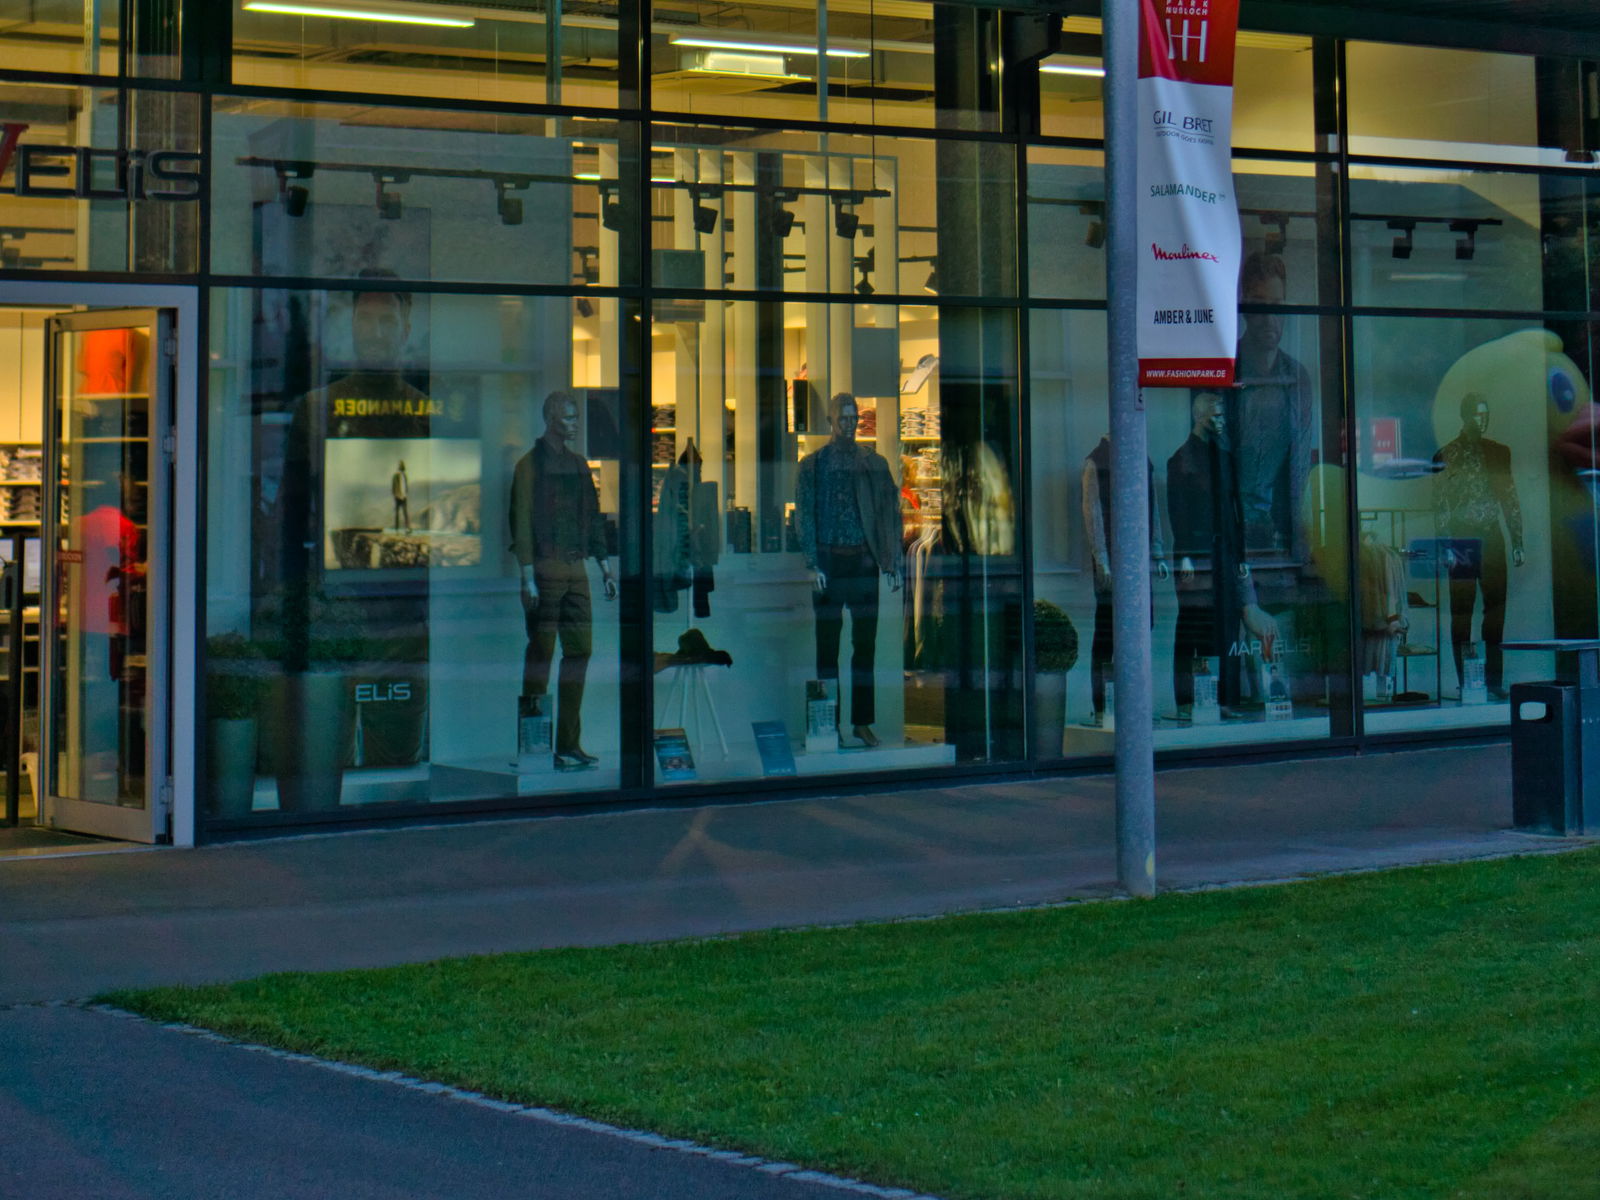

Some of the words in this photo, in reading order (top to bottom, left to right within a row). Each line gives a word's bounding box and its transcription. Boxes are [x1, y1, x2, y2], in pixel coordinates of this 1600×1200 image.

[1153, 110, 1176, 125] GIL
[1183, 116, 1213, 133] BRET
[1150, 184, 1217, 204] SALAMANDER
[1151, 243, 1219, 263] Moulinex
[1153, 309, 1184, 324] AMBER
[1185, 309, 1192, 324] &
[1194, 309, 1214, 324] JUNE
[1146, 369, 1226, 378] WWW.FASHIONPARK.DE
